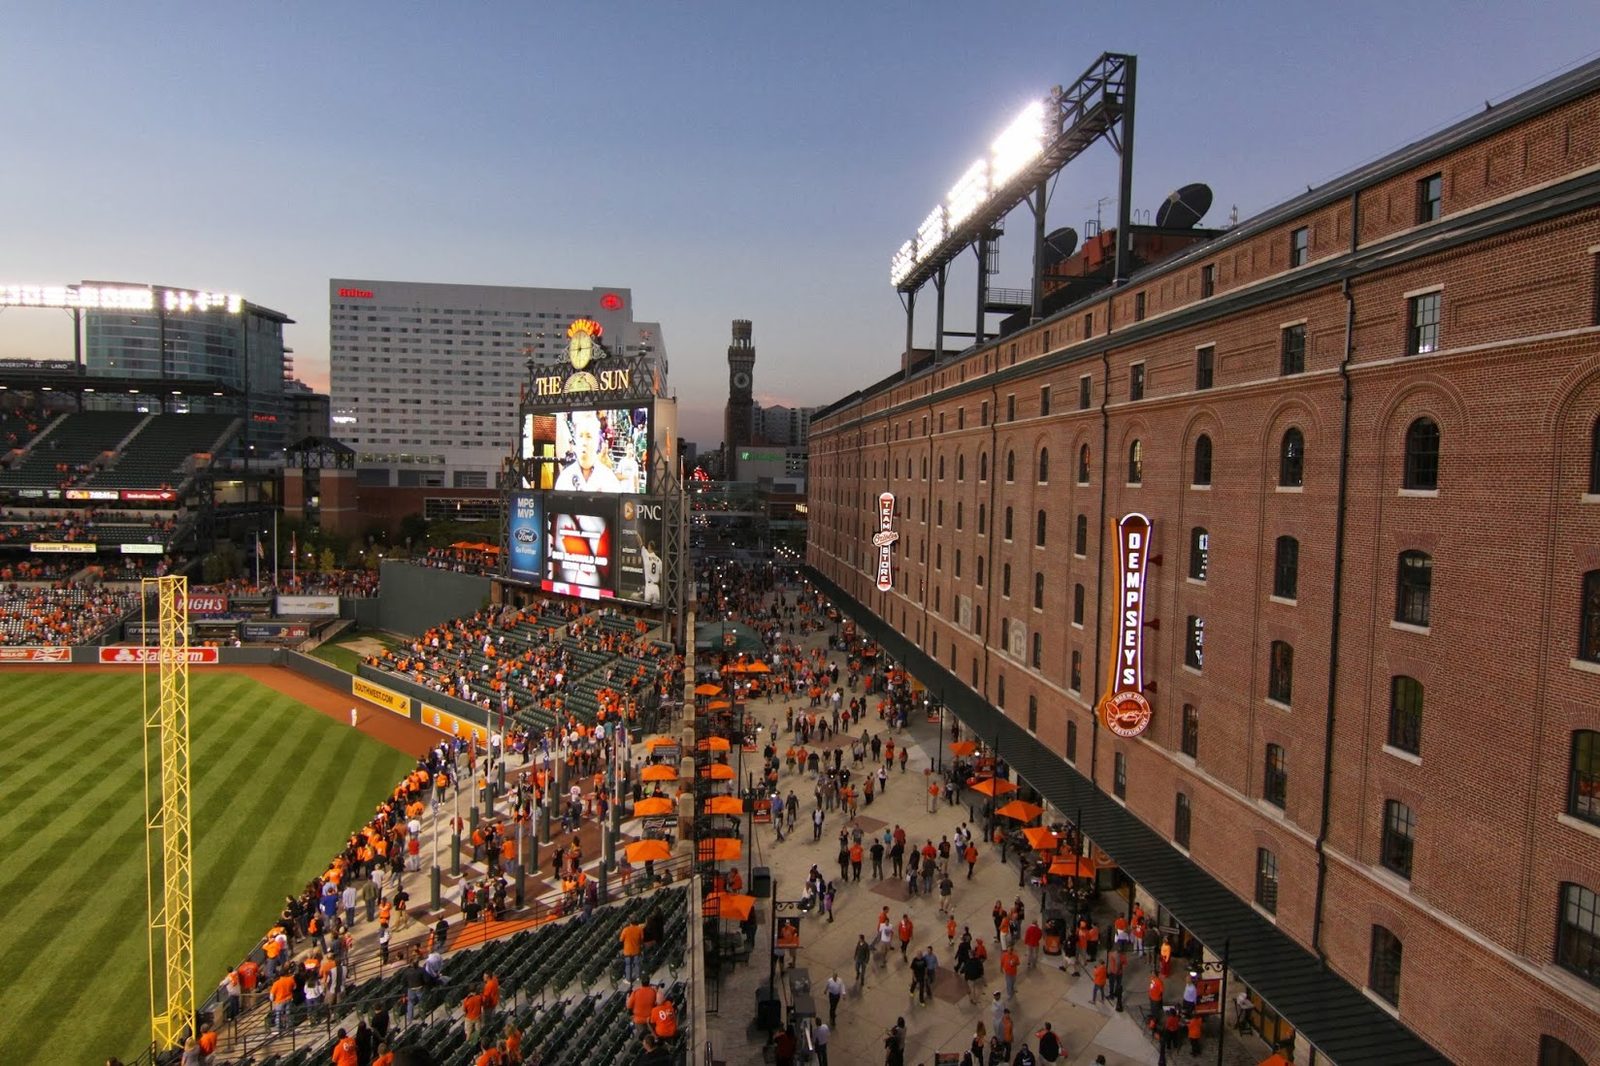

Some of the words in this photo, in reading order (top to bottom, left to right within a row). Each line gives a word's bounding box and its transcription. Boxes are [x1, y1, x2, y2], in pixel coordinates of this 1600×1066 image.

[536, 376, 562, 396] THE
[600, 369, 629, 391] SUN
[518, 498, 534, 508] MPG
[518, 508, 534, 518] MVP
[636, 504, 661, 520] PNC
[882, 501, 891, 529] TEAM
[651, 563, 656, 574] 8
[880, 547, 889, 582] STORE
[1122, 533, 1141, 685] DEMPSEYS
[172, 649, 204, 661] am
[354, 681, 395, 705] SOUTHWEST.COM
